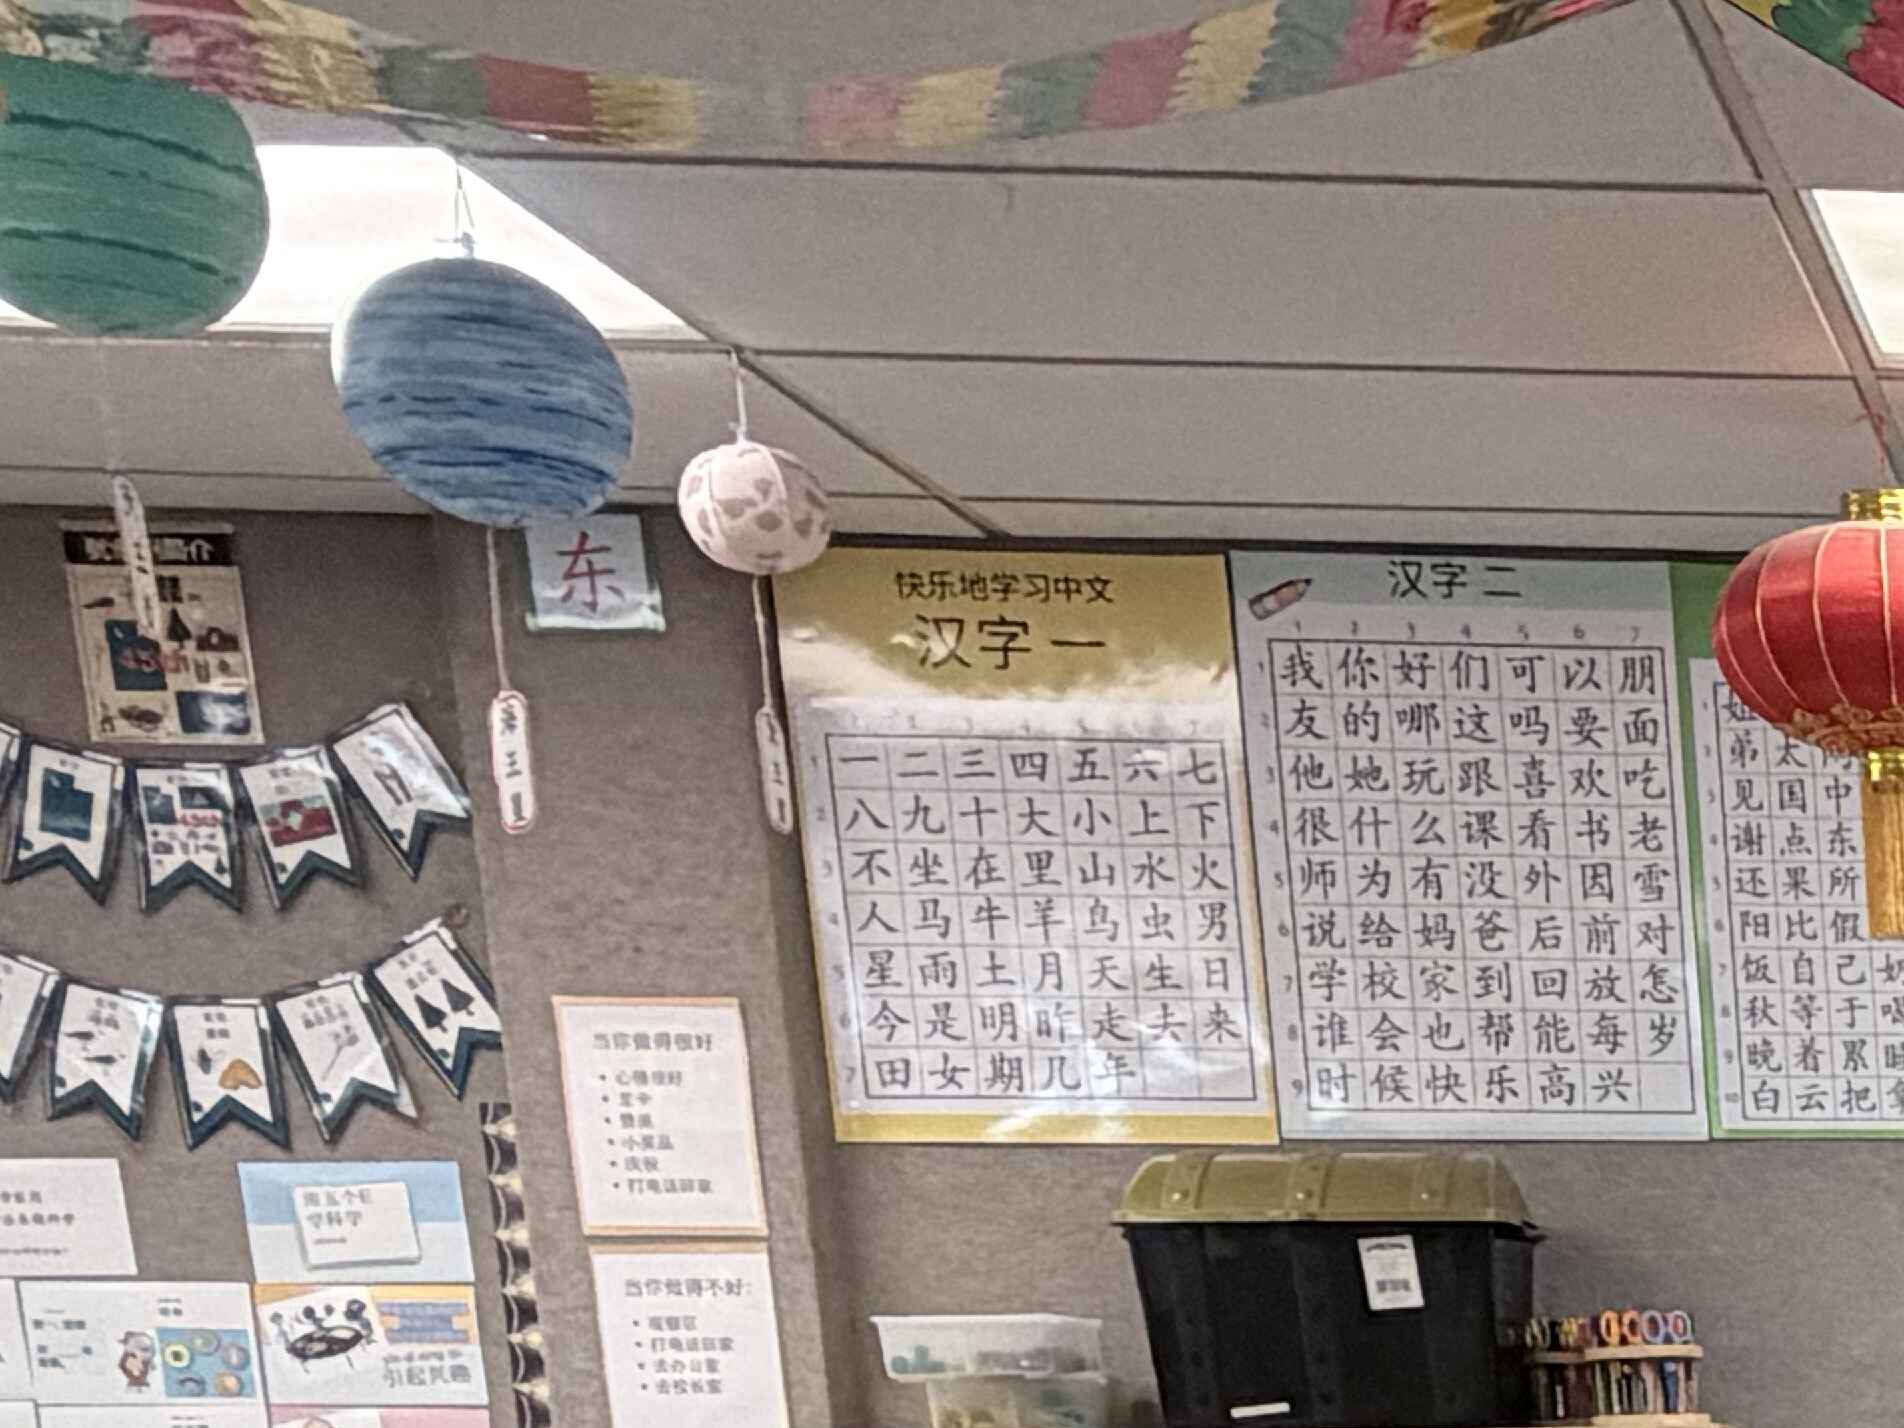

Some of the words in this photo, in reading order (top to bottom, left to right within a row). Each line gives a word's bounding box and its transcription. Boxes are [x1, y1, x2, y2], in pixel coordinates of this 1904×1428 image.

[560, 532, 623, 612] 东
[895, 570, 1115, 604] 快乐地学习中文
